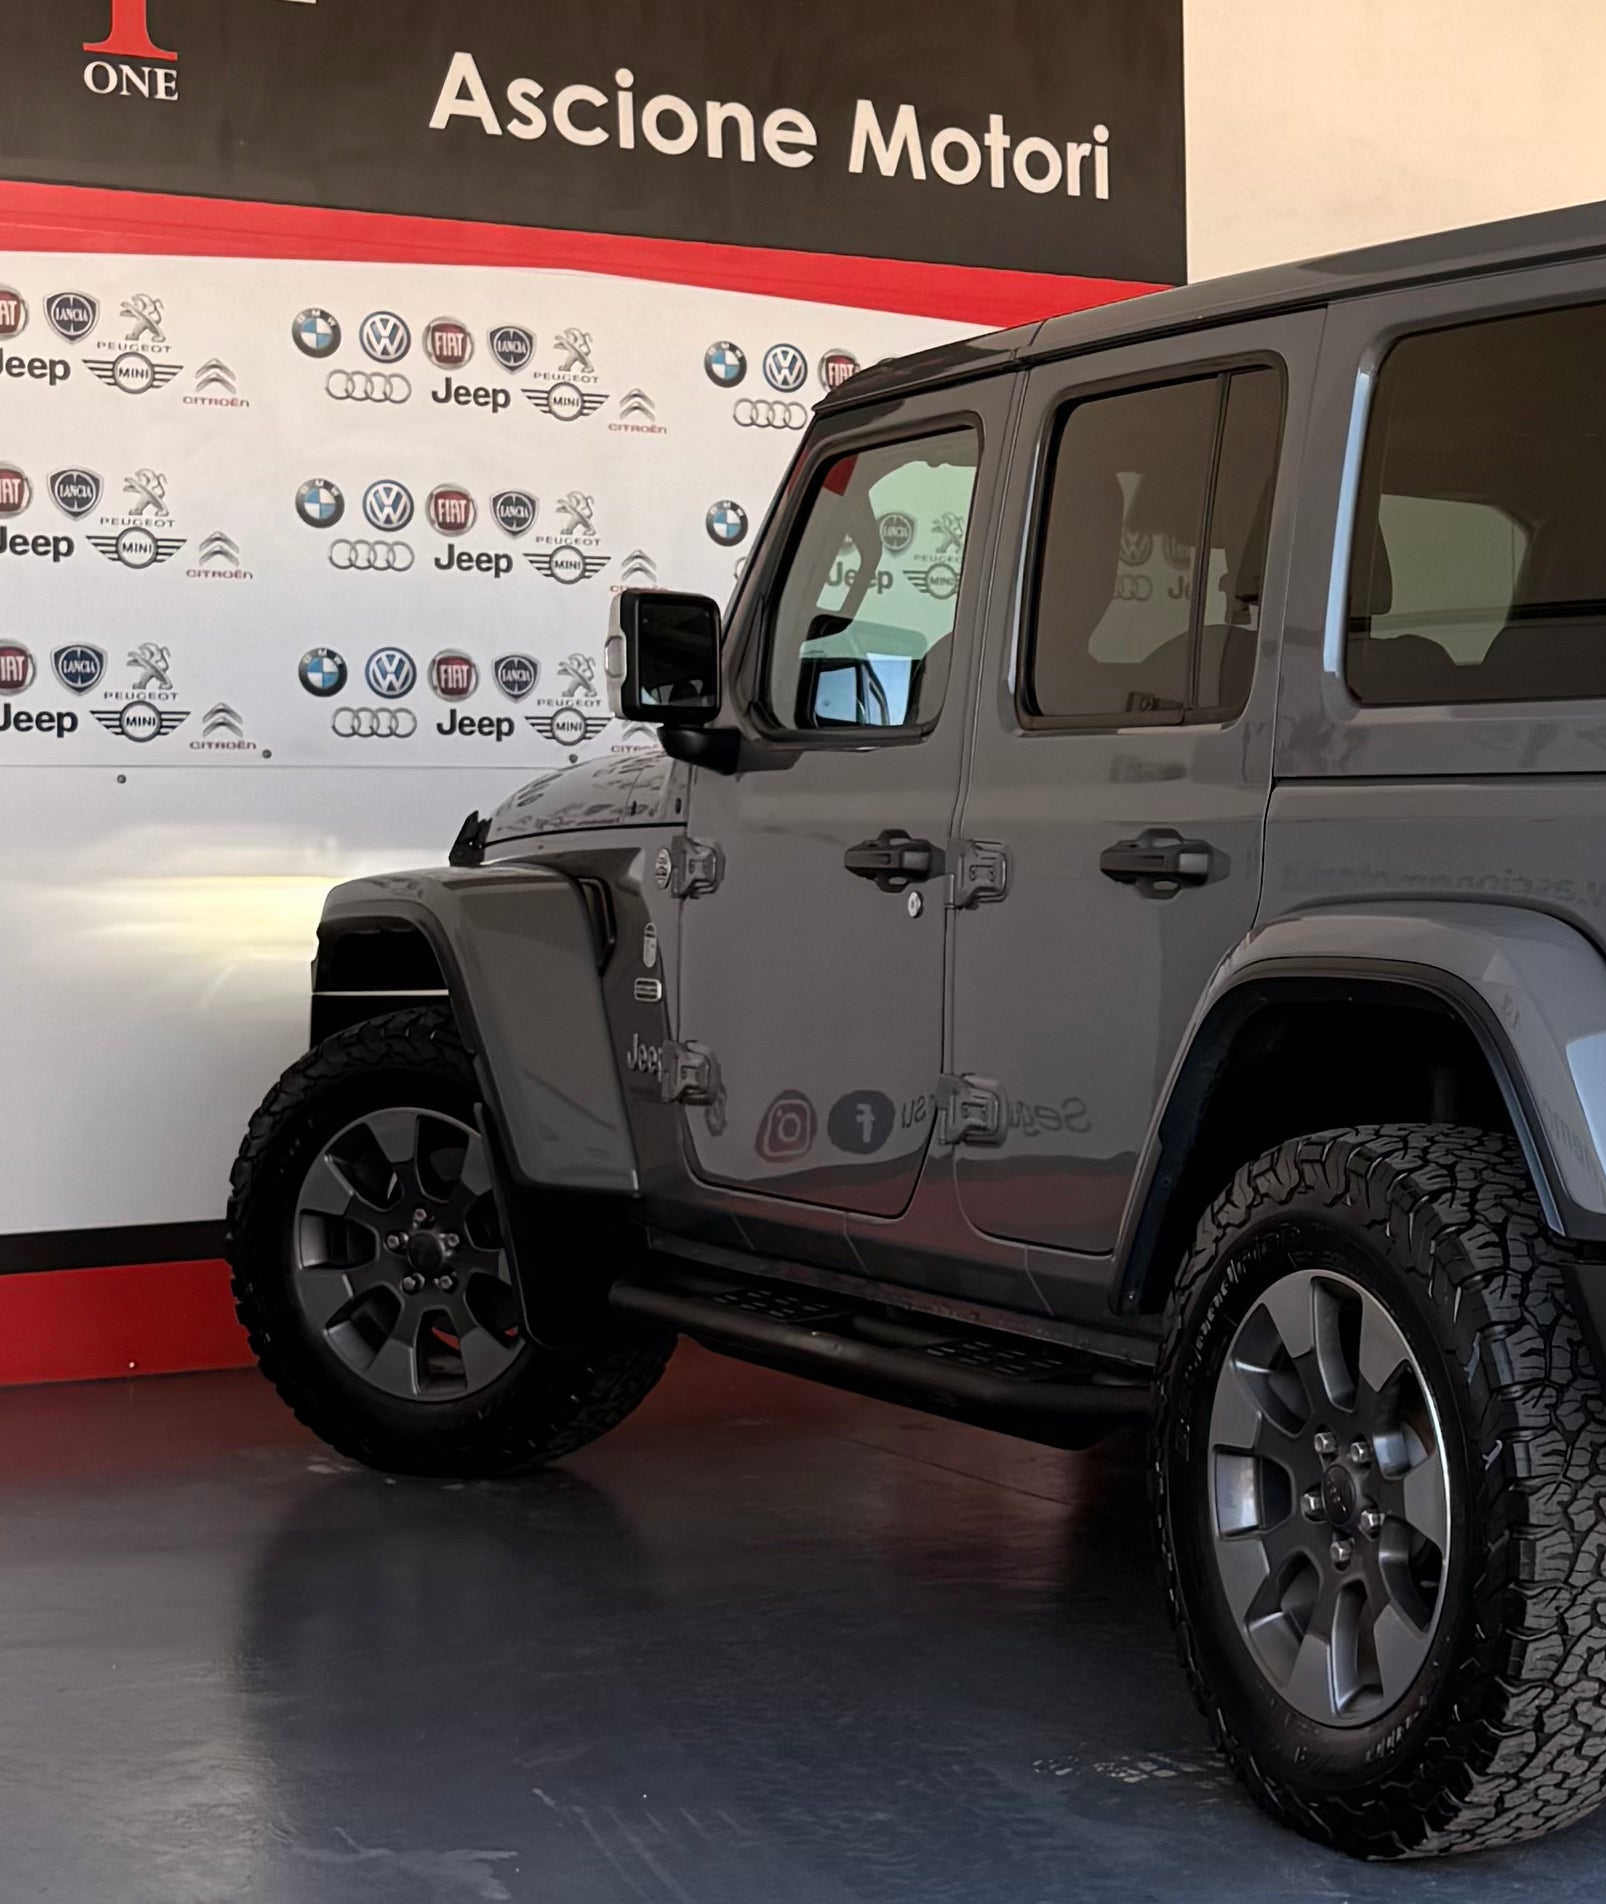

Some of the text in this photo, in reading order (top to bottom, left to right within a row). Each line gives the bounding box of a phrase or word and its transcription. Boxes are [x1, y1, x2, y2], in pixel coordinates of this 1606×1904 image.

[84, 60, 178, 101] ONE
[428, 51, 1110, 200] Ascione Motori
[0, 300, 17, 326] AT
[55, 306, 90, 323] LANCIA
[97, 341, 172, 354] PEUGEOT
[434, 331, 466, 358] FIAT
[497, 339, 529, 355] LANCIA
[0, 348, 70, 386] eep
[118, 367, 150, 380] MINI
[533, 370, 600, 384] PEUGEOT
[431, 376, 511, 413] Jeep
[553, 395, 581, 408] MINI
[59, 484, 93, 499] LANCIA
[437, 498, 468, 523] FIAT
[500, 505, 530, 520] LANCIA
[100, 516, 175, 528] PEUGEOT
[122, 541, 153, 554] MINI
[536, 535, 601, 547] PEUGEOT
[434, 543, 513, 579] Jeep
[555, 559, 581, 571] MINI
[0, 656, 25, 682] IAT
[63, 659, 96, 674] LANCIA
[440, 664, 469, 689] FIAT
[501, 667, 531, 682] LANCIA
[104, 691, 178, 701] PEUGEOT
[537, 698, 602, 708] PEUGEOT
[125, 715, 157, 727] MINI
[436, 708, 515, 742] Jeep
[556, 721, 582, 733] MINI
